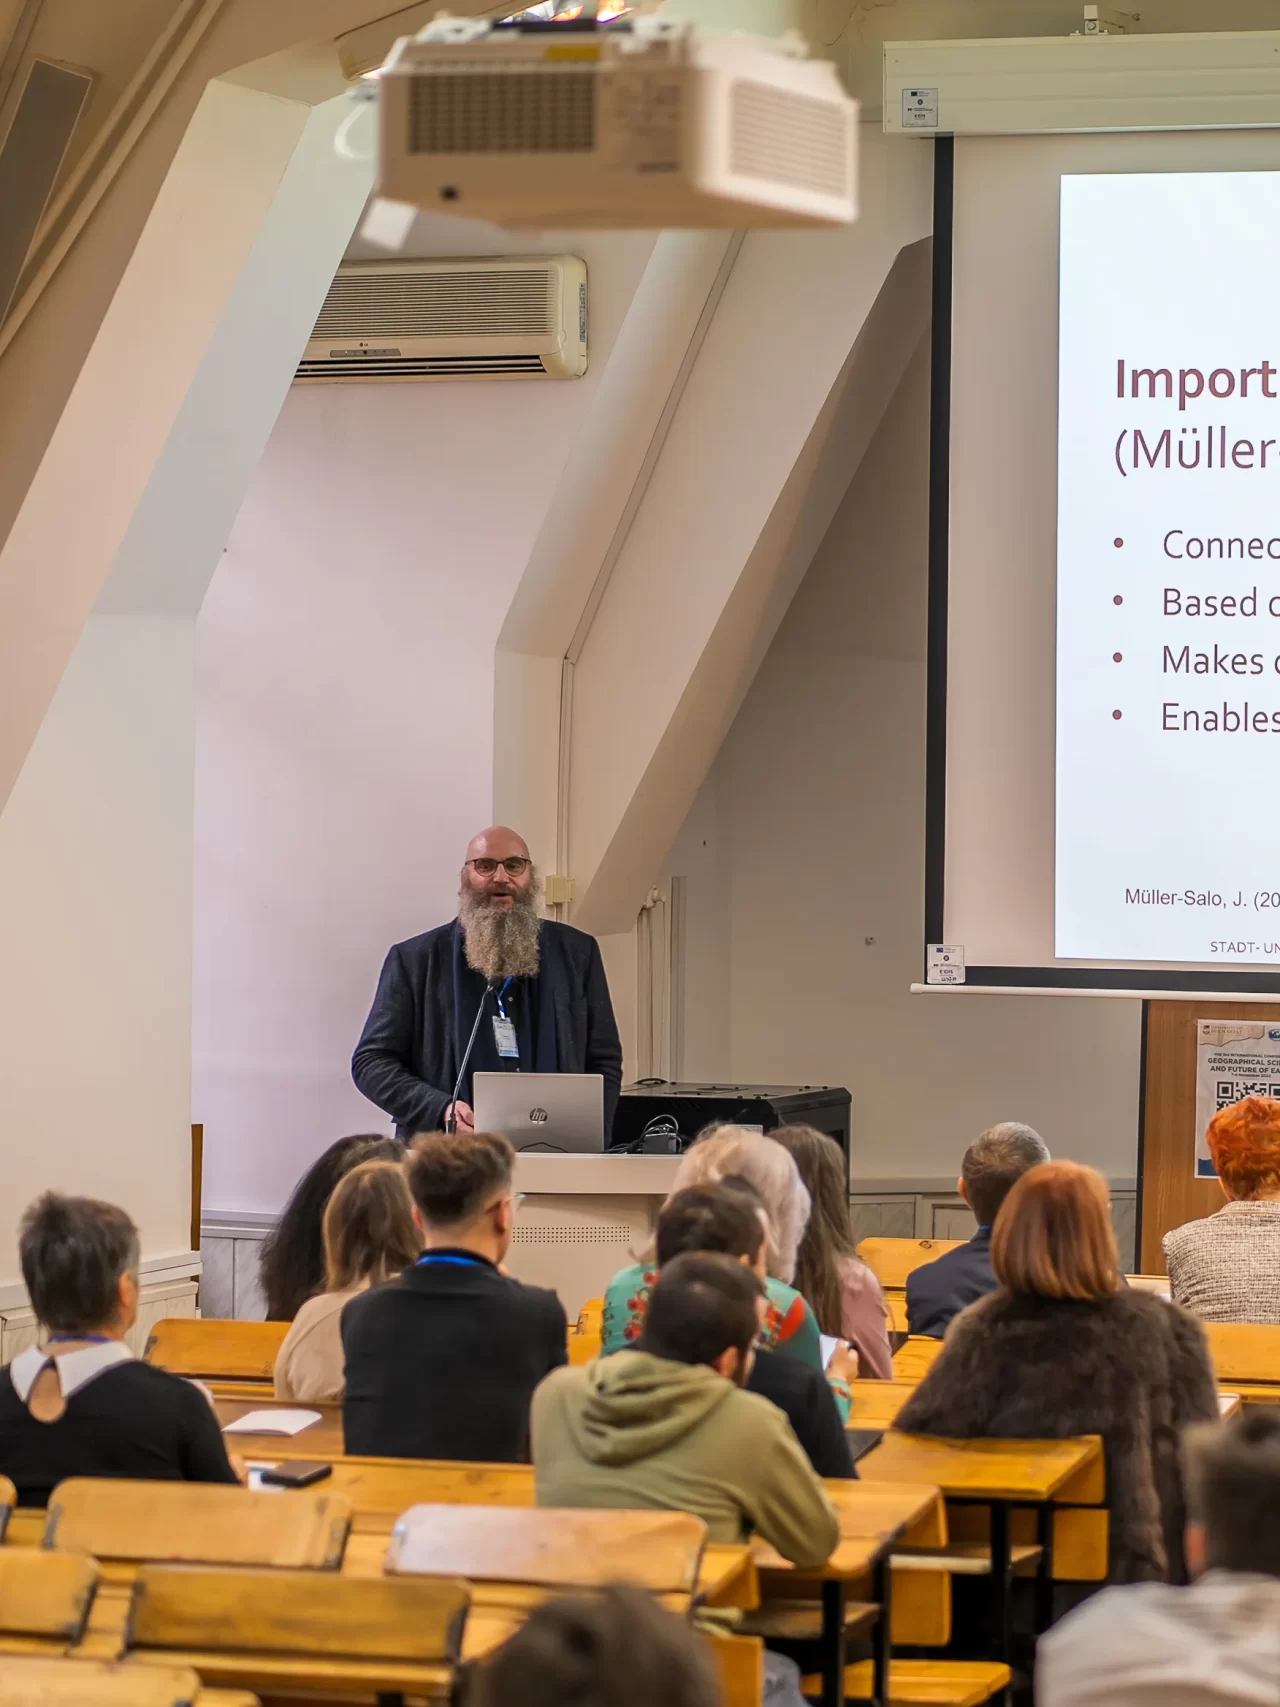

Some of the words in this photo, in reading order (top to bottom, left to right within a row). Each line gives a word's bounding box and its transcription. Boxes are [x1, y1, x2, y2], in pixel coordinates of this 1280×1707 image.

[1163, 586, 1257, 618] Based
[1163, 643, 1264, 676] Makes
[1125, 887, 1227, 909] Müller-Salo,
[1232, 890, 1247, 907] J.
[1210, 941, 1261, 955] STADT-
[1208, 1057, 1265, 1066] GEOGRAPHICAL
[531, 1108, 546, 1124] hp
